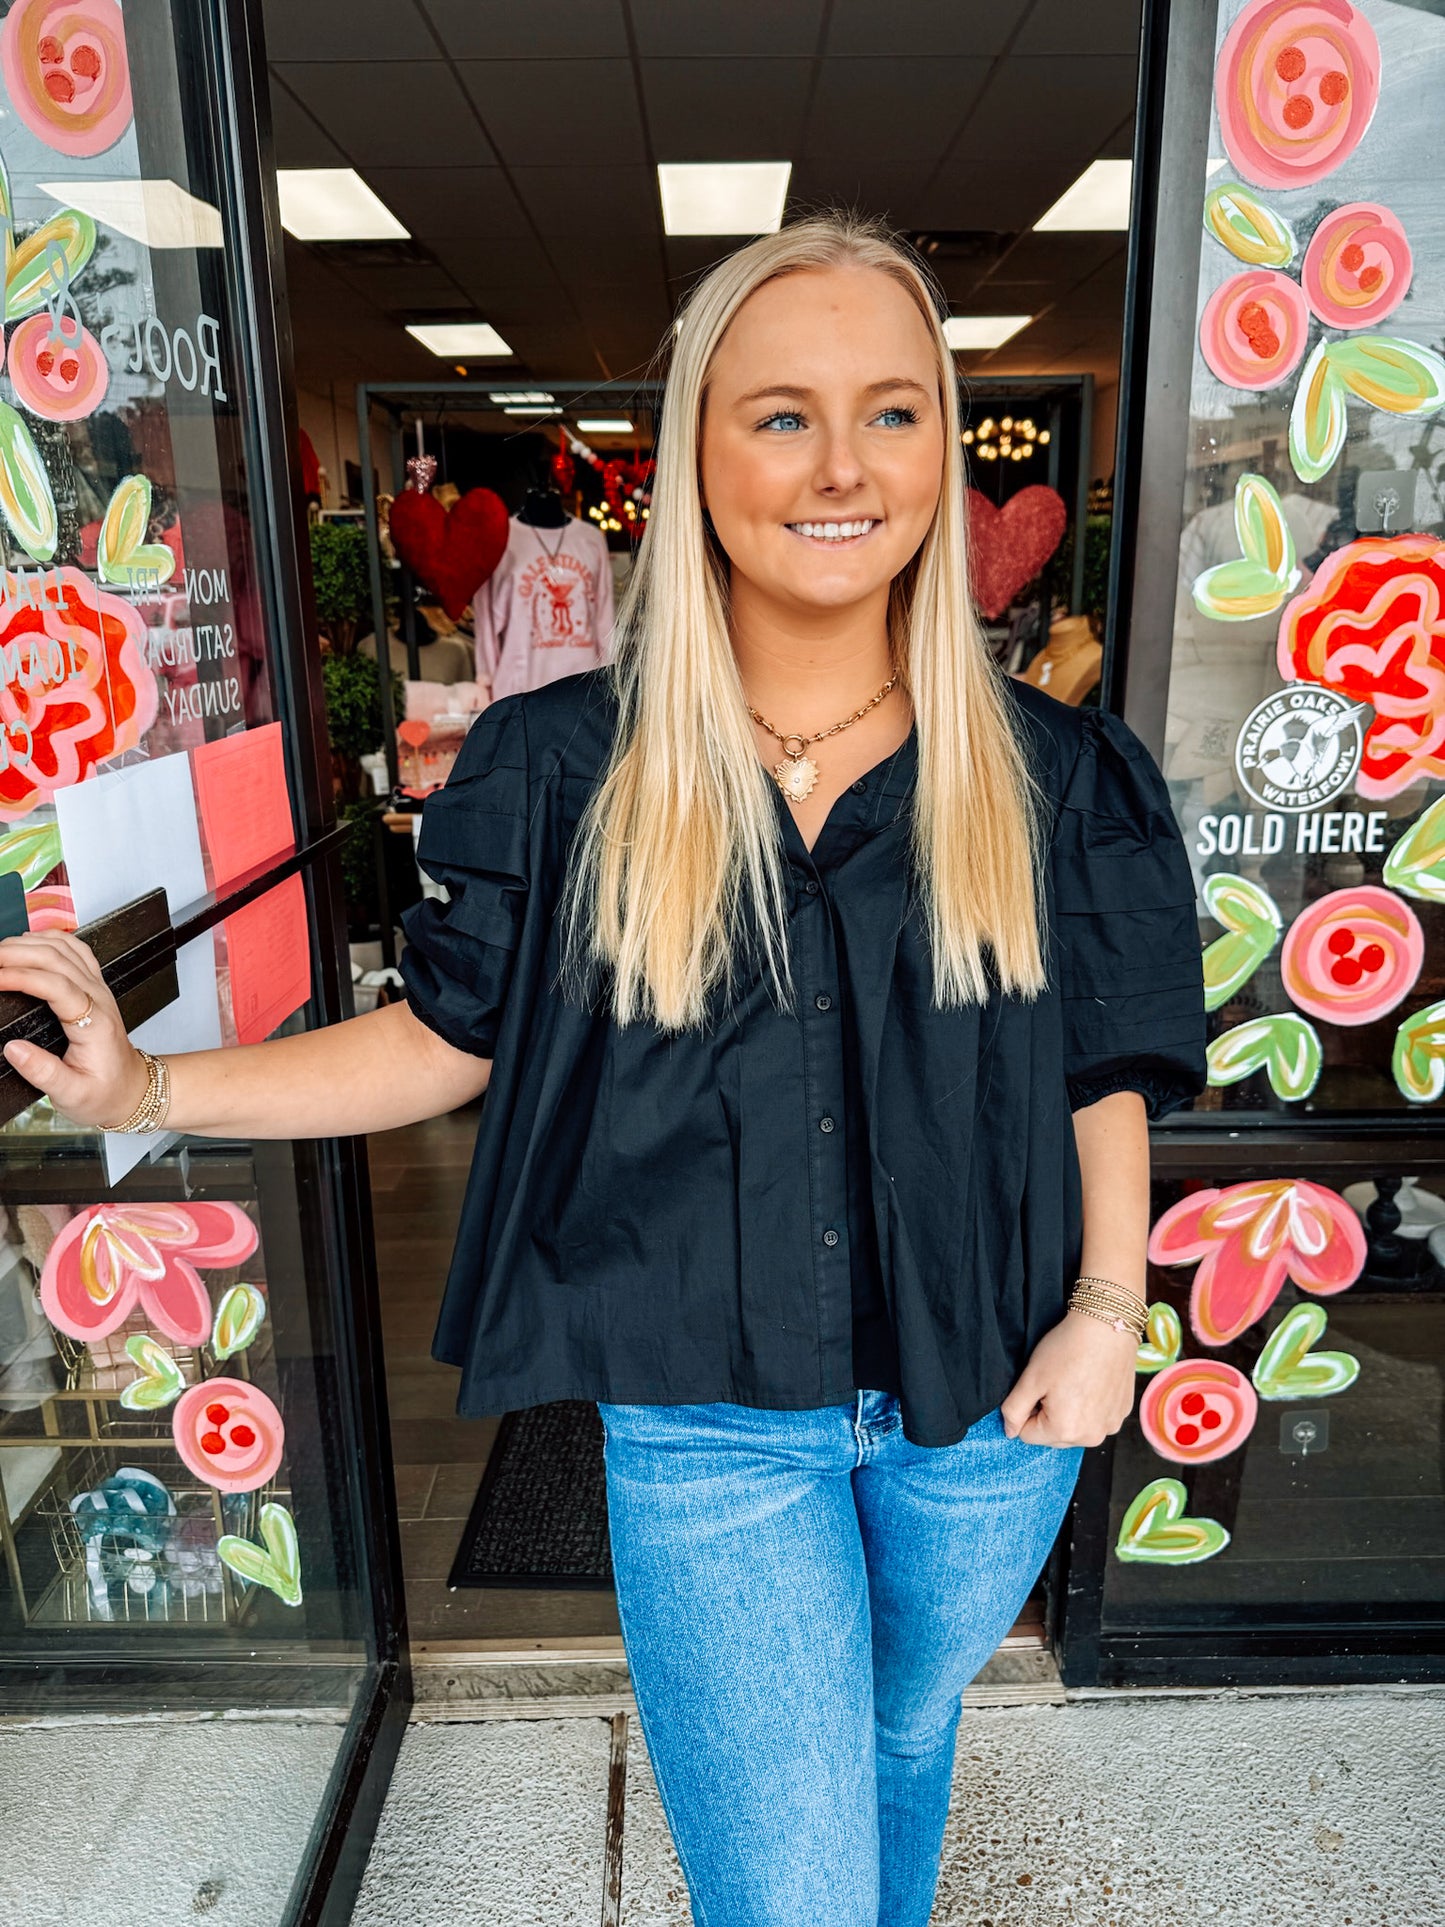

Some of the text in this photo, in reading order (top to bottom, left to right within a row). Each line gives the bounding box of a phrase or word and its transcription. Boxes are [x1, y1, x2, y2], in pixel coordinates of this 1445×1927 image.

[1243, 694, 1341, 768] PRAIRIE OAKS
[1262, 746, 1356, 806] WATERFOWL
[1196, 811, 1389, 856] SOLD HERE
